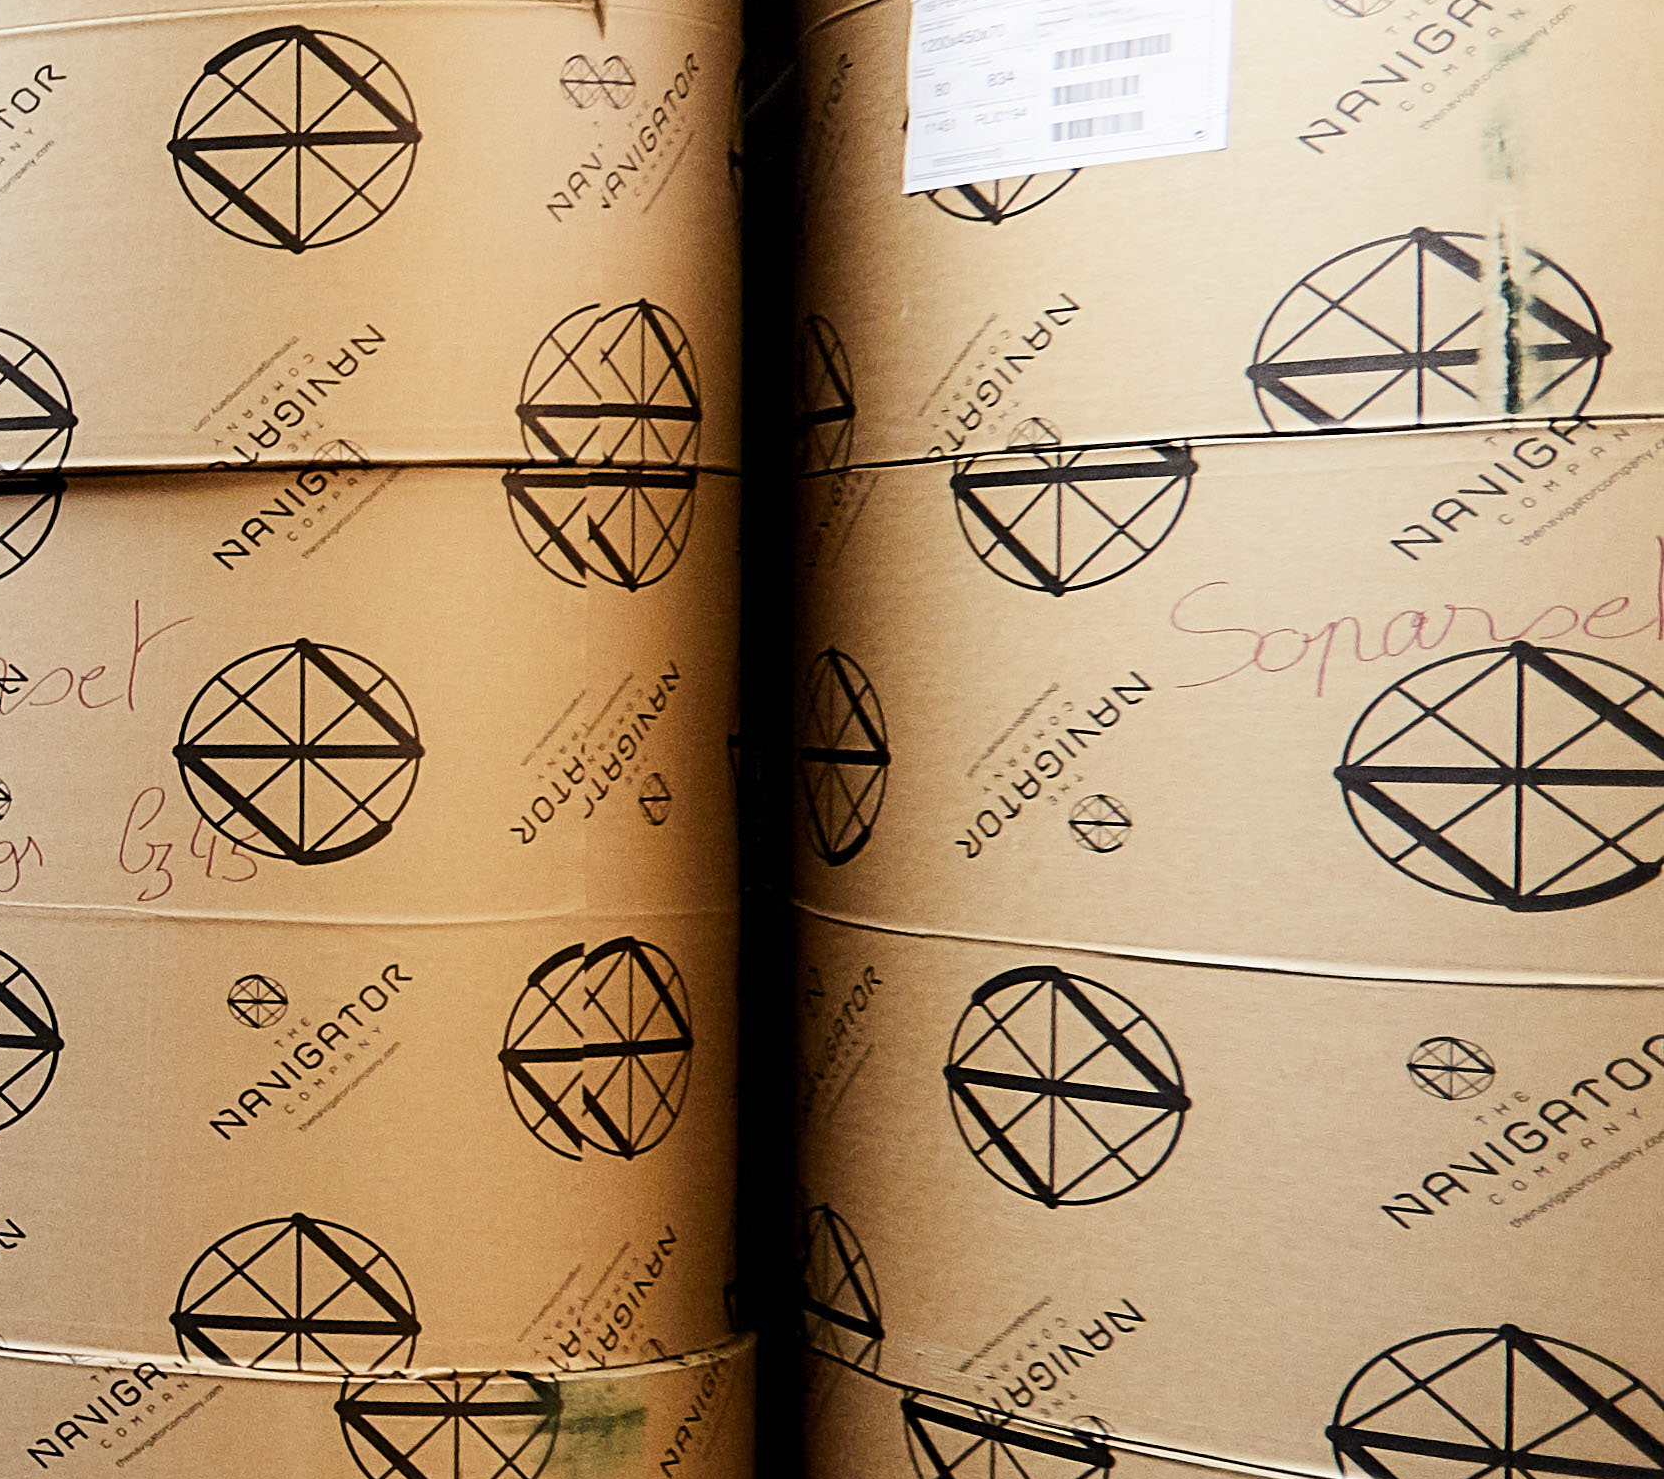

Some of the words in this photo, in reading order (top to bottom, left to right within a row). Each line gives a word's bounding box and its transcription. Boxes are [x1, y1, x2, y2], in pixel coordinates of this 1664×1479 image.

[214, 352, 316, 446] COMPANY
[955, 670, 1153, 860] NAVIGATOR
[209, 963, 412, 1140] NAVIGATOR
[273, 1015, 312, 1050] THE
[284, 1026, 384, 1115] COMPANY
[1381, 1033, 1664, 1231] NAVIGATO
[1475, 1090, 1534, 1128] THE
[1489, 1105, 1643, 1207] COMPANY
